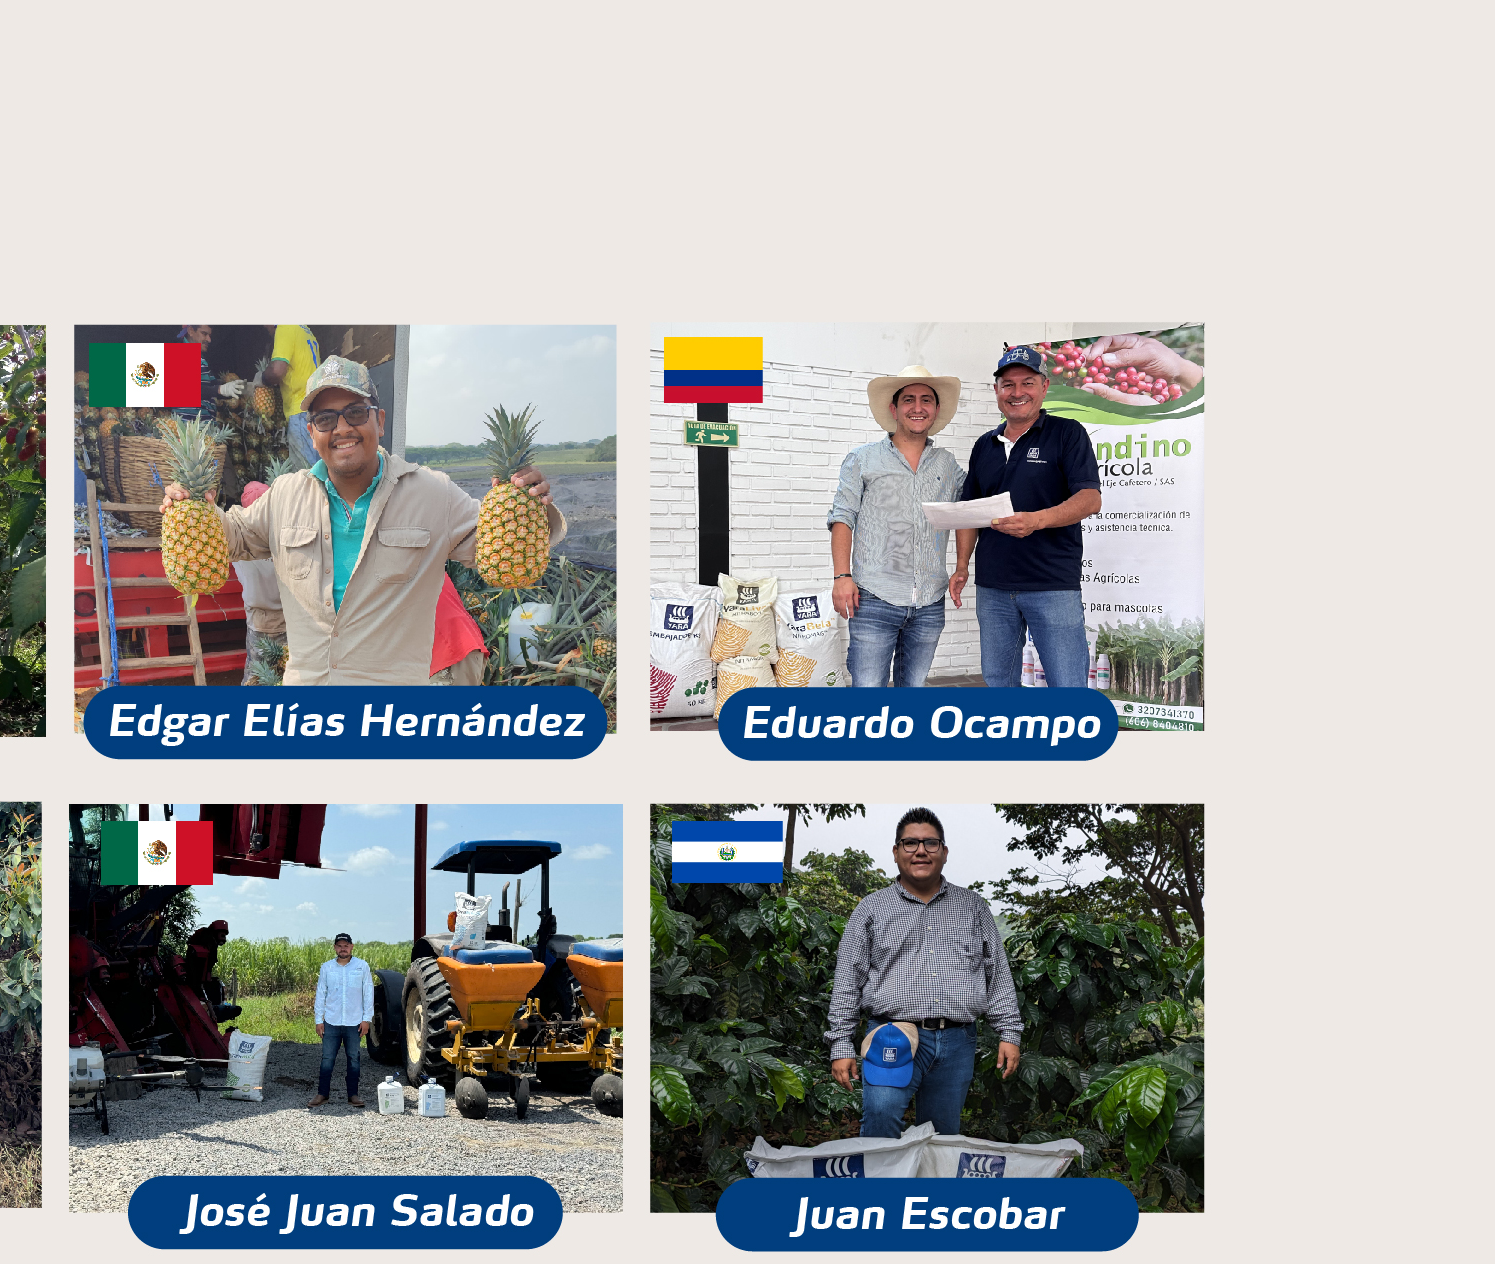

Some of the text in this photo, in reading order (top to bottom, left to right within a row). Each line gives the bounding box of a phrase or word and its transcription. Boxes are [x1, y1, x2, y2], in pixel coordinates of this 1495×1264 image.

[1093, 572, 1140, 585] Agrícolas
[1090, 602, 1164, 614] para mascotas
